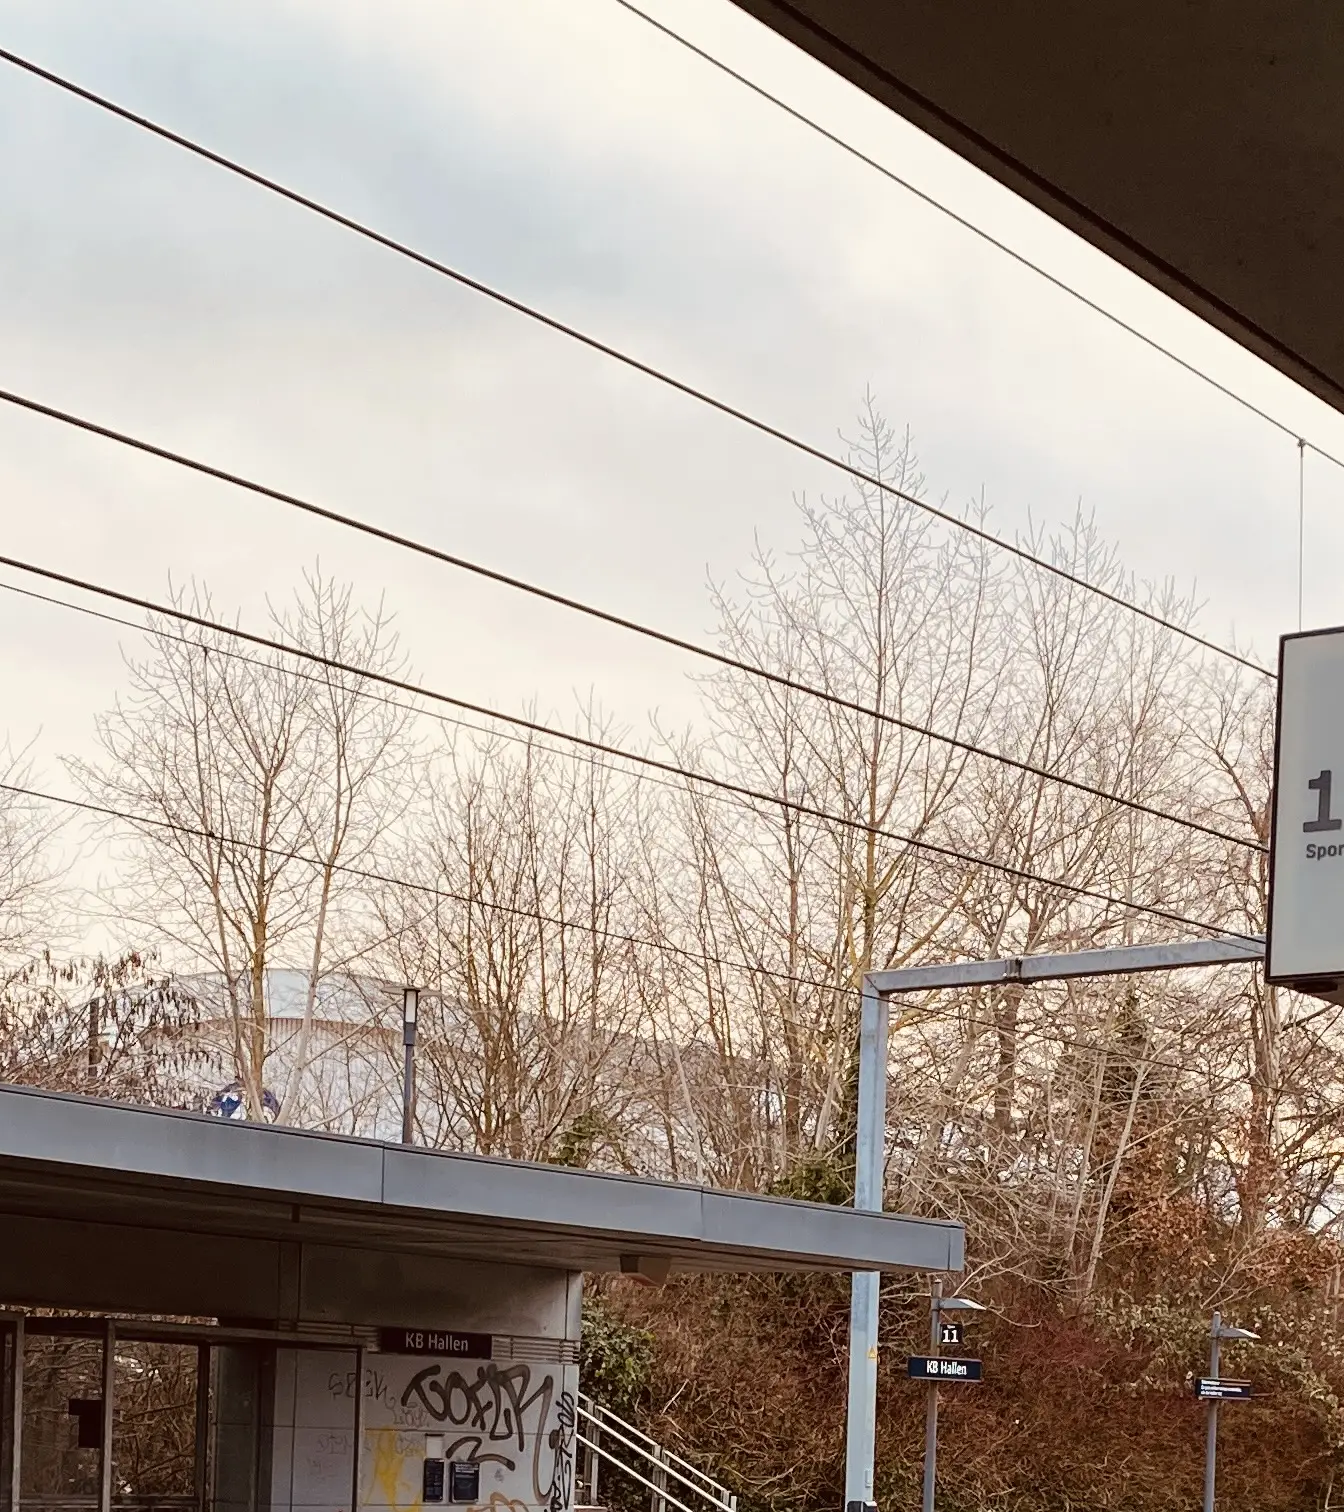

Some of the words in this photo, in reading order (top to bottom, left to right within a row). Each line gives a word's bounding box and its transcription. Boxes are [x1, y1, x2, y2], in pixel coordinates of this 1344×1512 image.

[405, 1332, 424, 1349] KB
[428, 1333, 469, 1351] Hallen
[942, 1329, 959, 1343] 11
[926, 1360, 939, 1374] KB
[940, 1361, 967, 1375] Hallen
